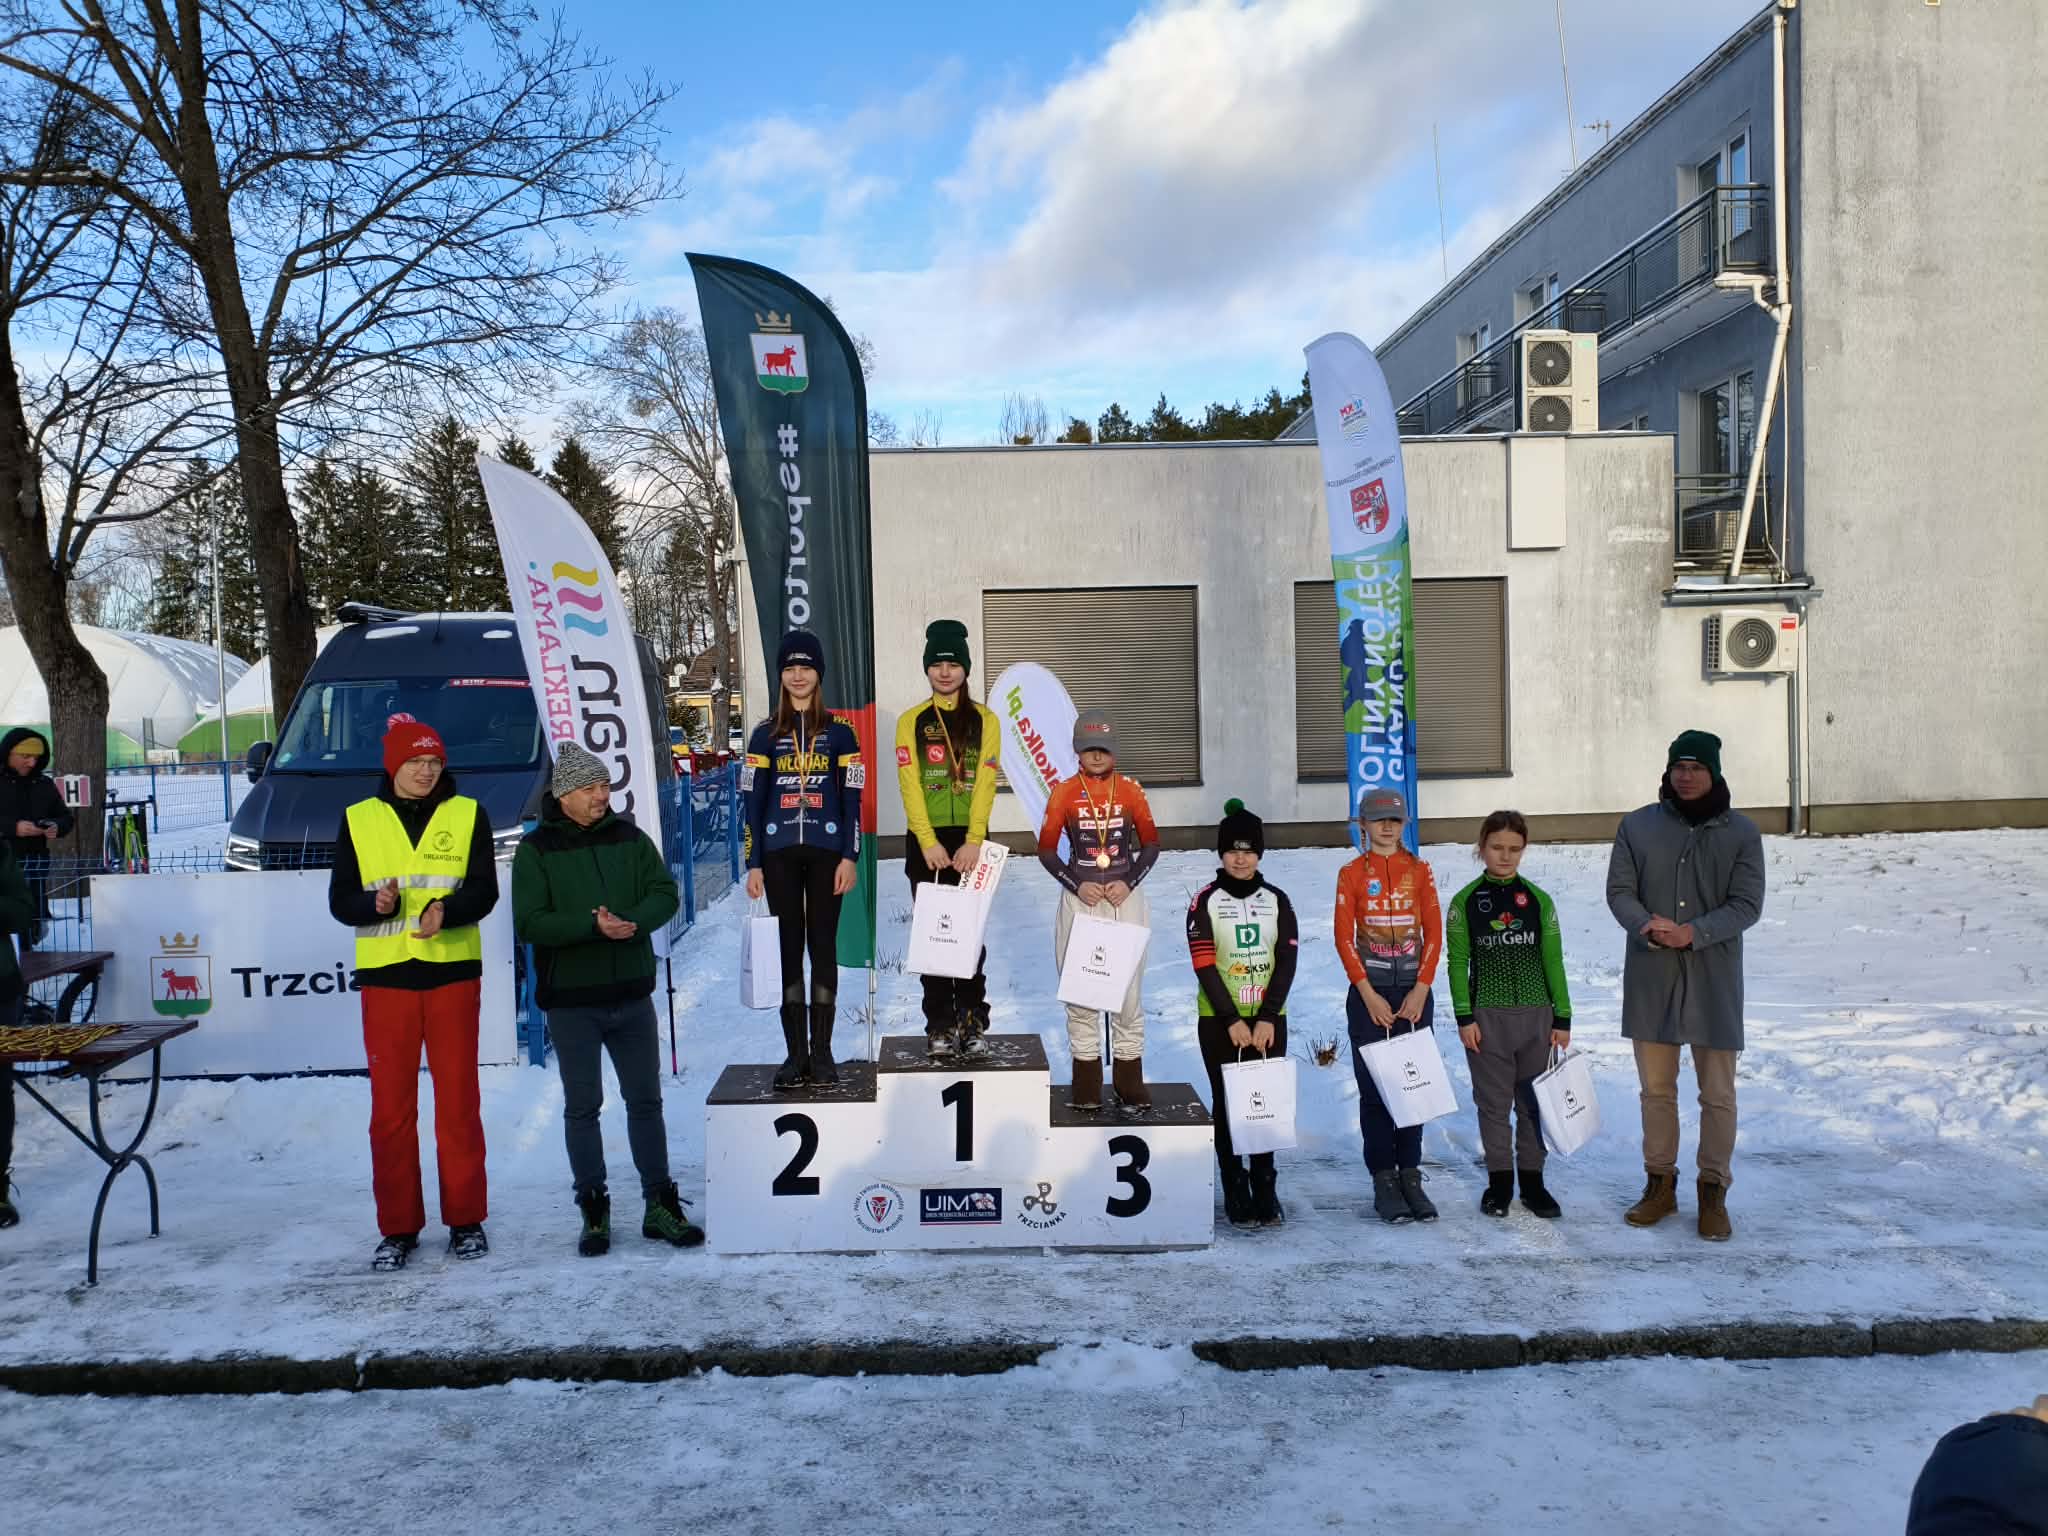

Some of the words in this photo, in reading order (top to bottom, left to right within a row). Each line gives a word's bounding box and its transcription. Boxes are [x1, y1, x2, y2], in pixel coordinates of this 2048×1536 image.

[776, 775, 829, 785] GIANT
[847, 767, 865, 784] 386
[65, 780, 79, 803] H
[423, 853, 463, 863] ORGANIZATOR
[1367, 899, 1414, 911] KLIF
[1240, 927, 1257, 944] D
[1476, 931, 1535, 949] agriGeM
[941, 1080, 974, 1162] 1
[772, 1113, 820, 1196] 2
[1105, 1135, 1152, 1218] 3
[925, 1195, 969, 1211] UIM
[1017, 1211, 1068, 1230] TRZCIANKA
